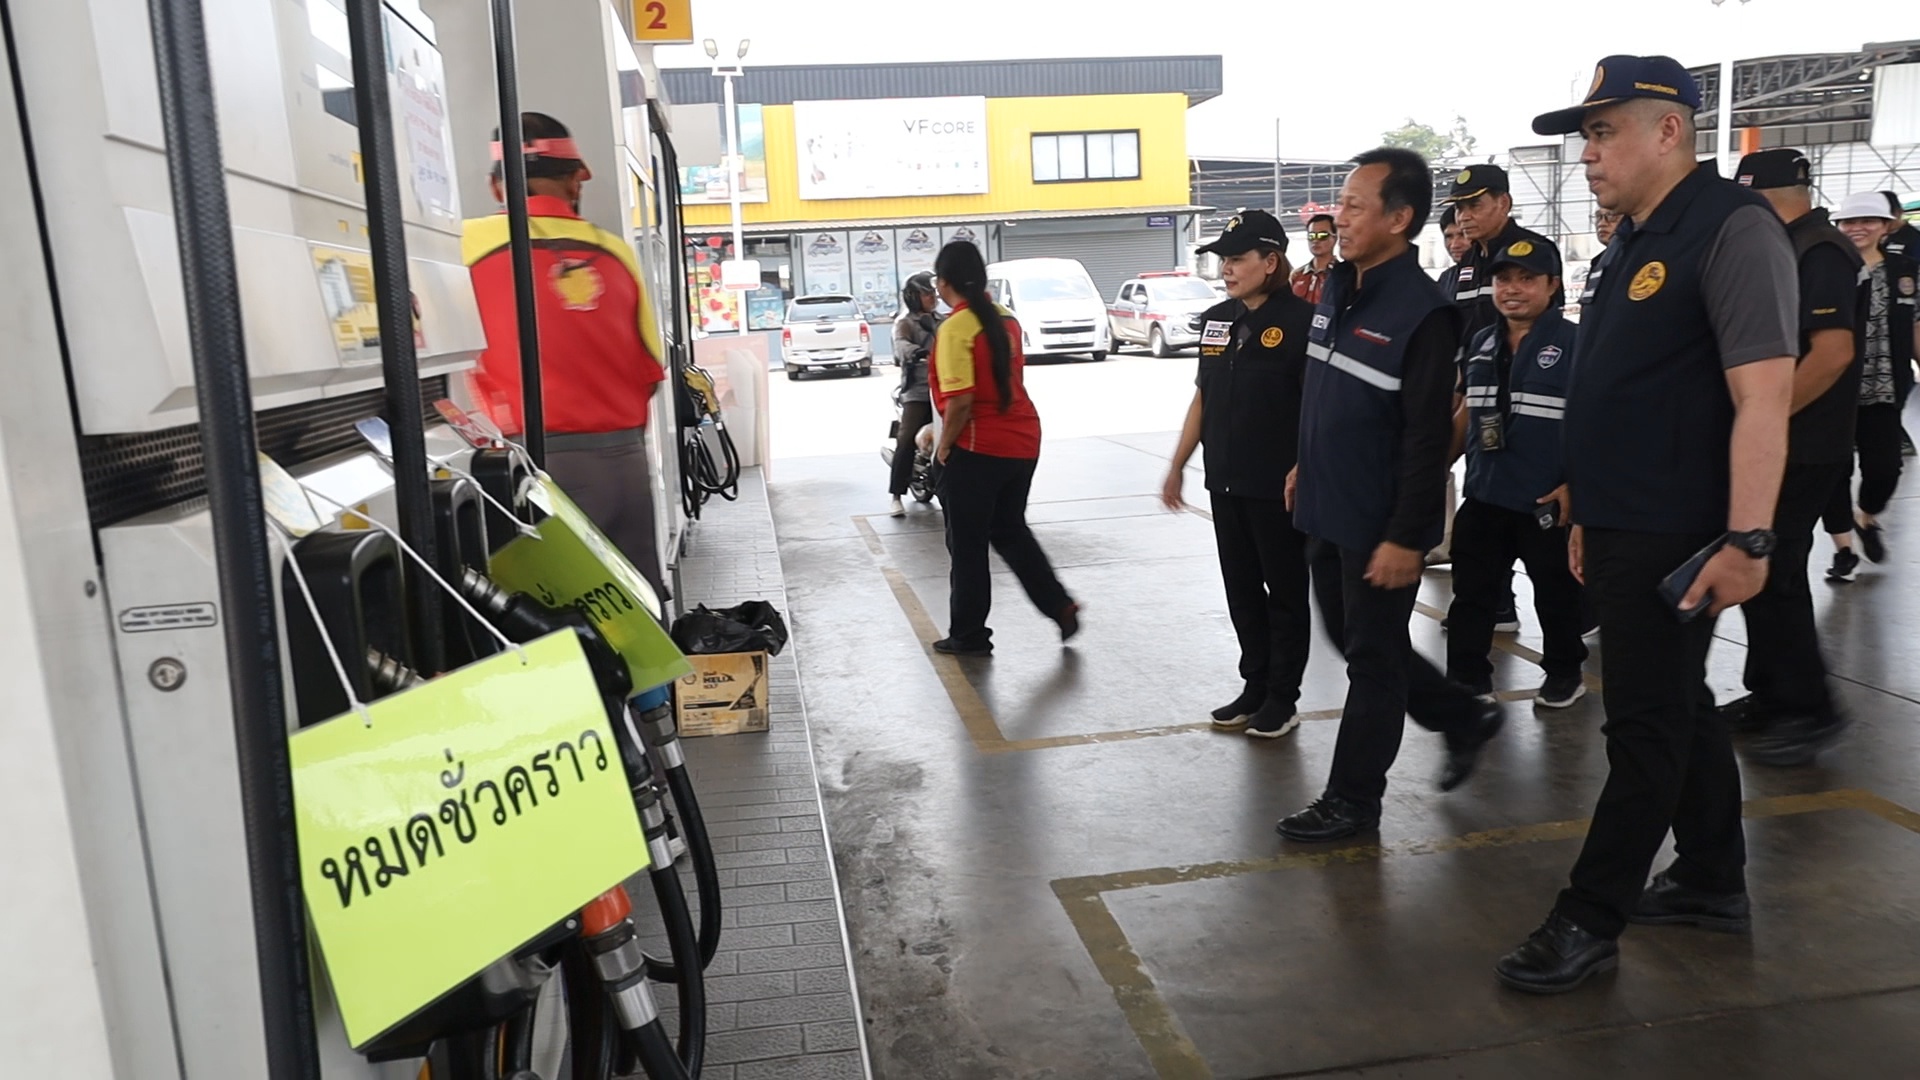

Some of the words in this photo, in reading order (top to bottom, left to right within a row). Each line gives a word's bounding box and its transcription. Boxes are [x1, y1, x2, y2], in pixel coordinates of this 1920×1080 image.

[645, 1, 667, 29] 2
[703, 673, 736, 684] HELIX
[320, 729, 608, 909] หมดชั่วคราว
